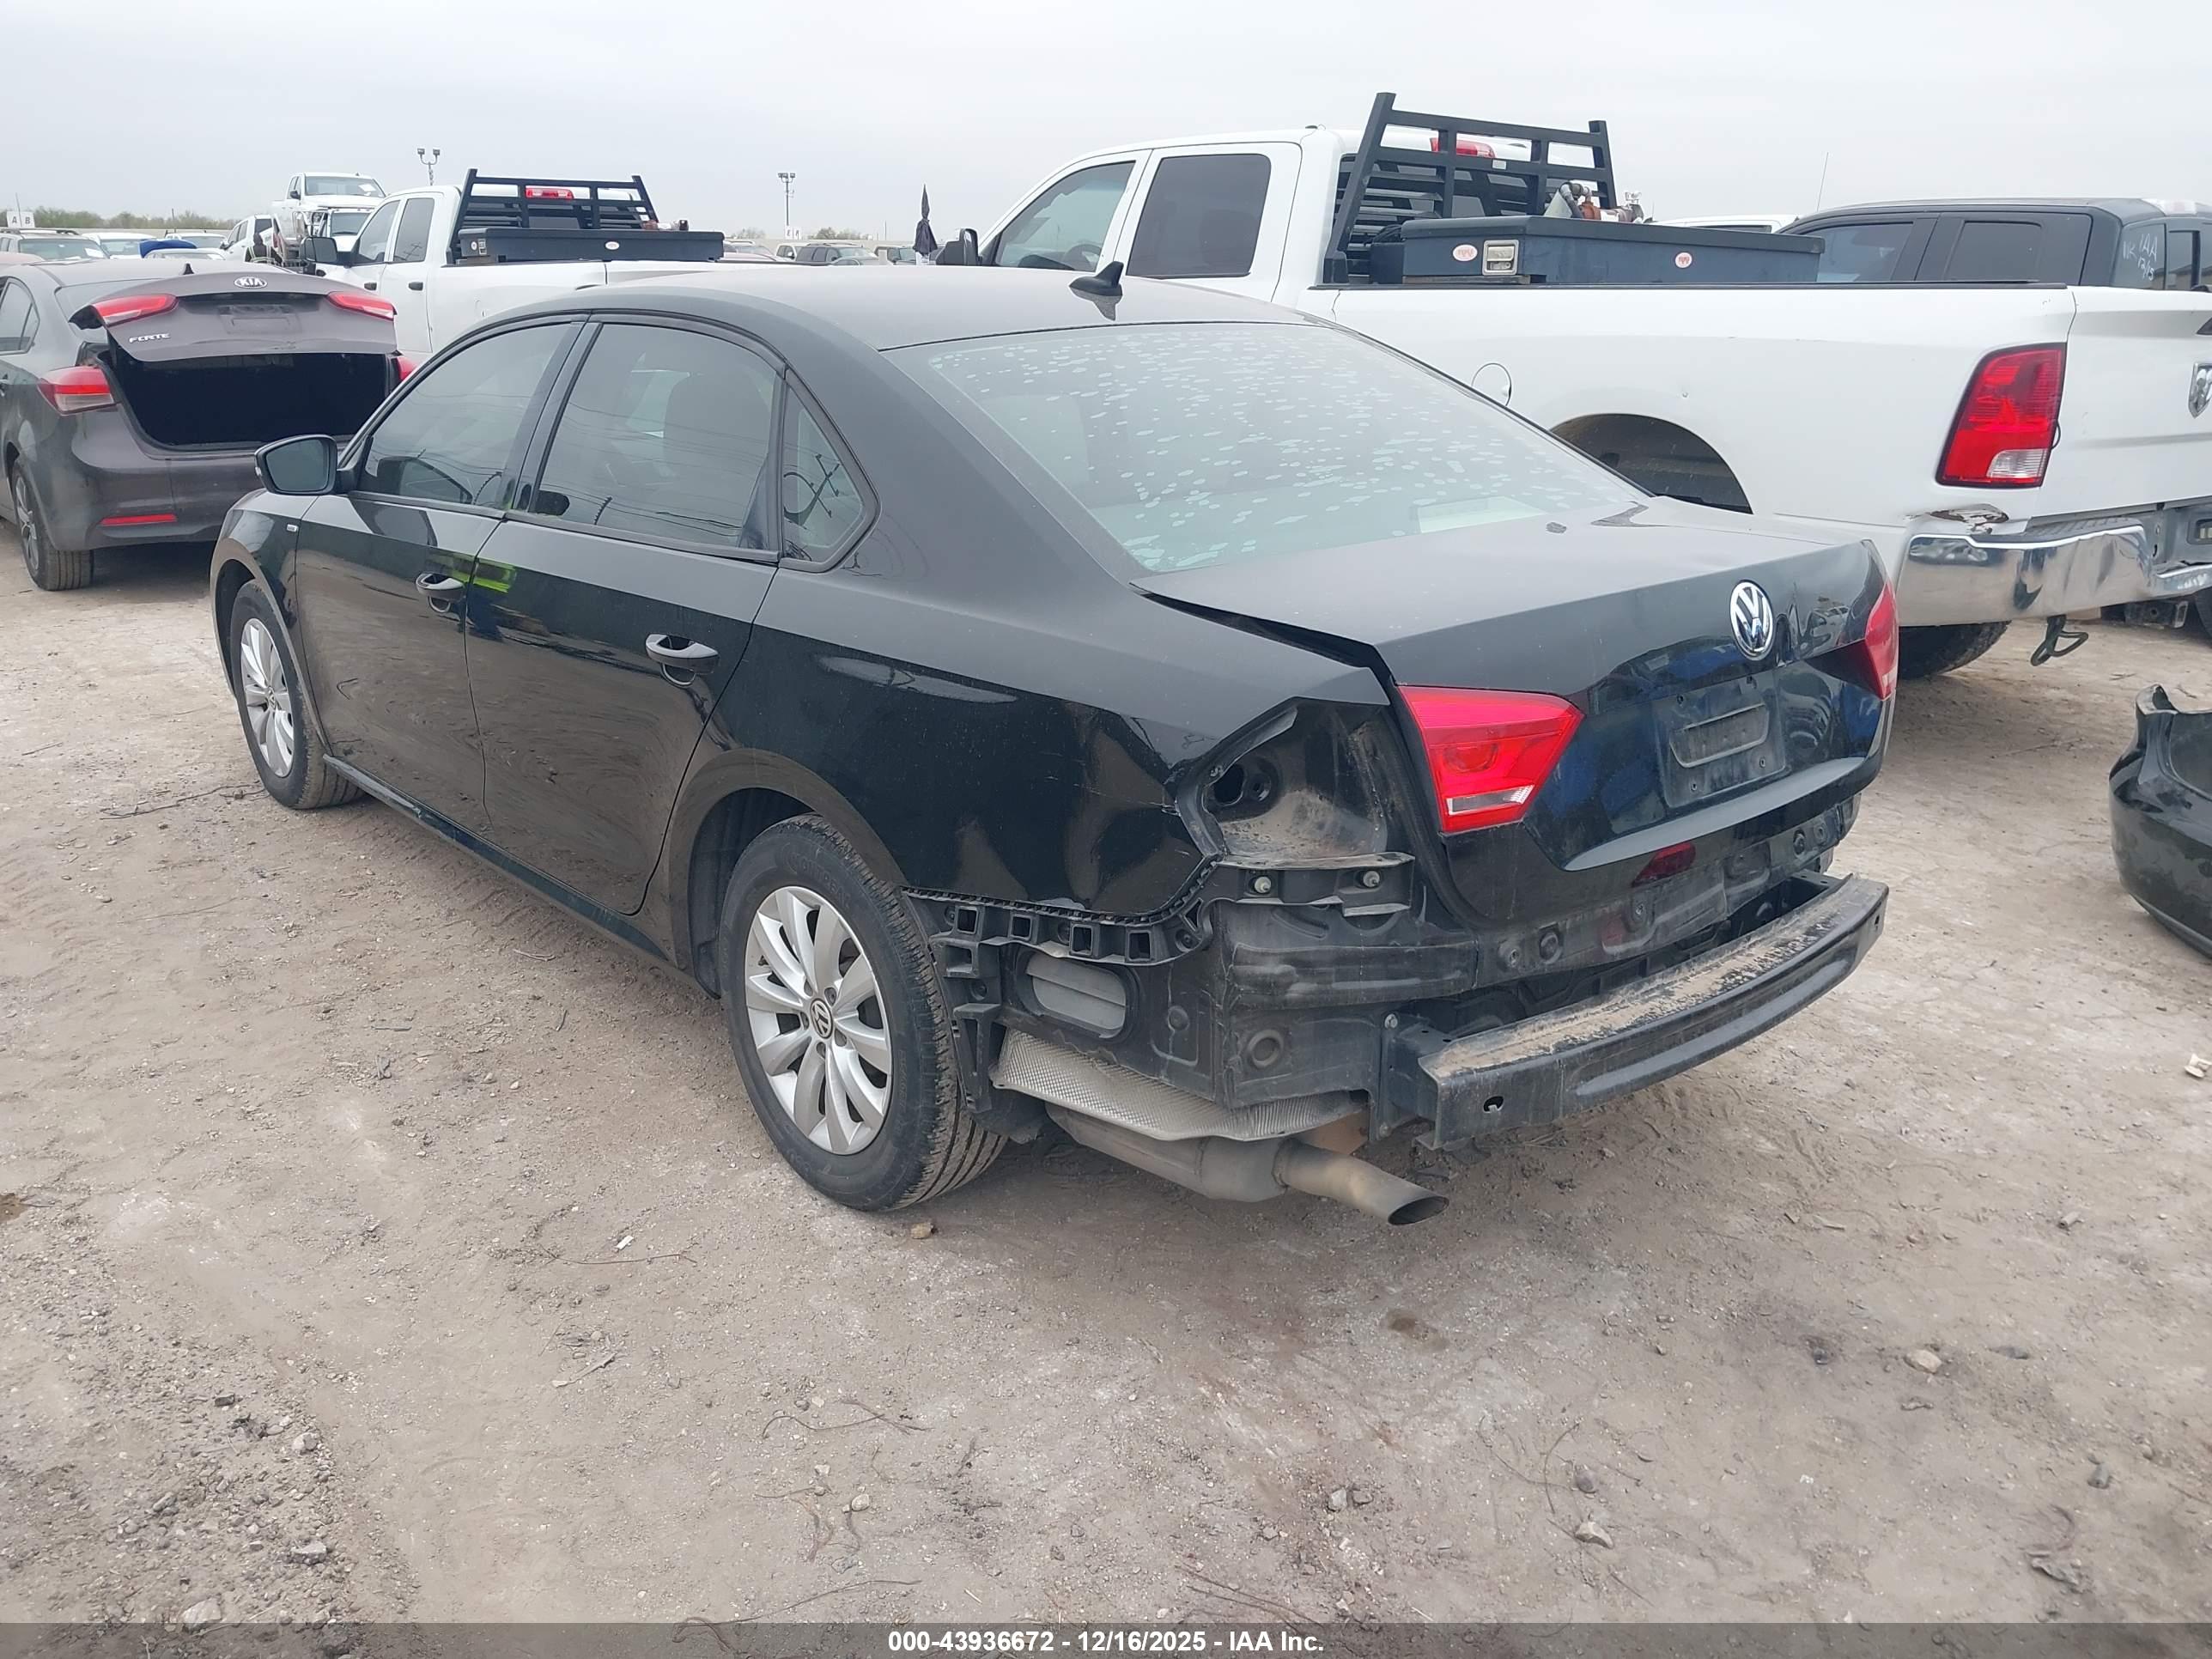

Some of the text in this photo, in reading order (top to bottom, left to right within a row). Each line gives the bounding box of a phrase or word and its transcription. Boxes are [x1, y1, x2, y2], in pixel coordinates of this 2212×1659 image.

[12, 216, 17, 224] A
[240, 276, 264, 287] KIA
[129, 332, 170, 343] FORTE
[1730, 582, 1772, 659] VW
